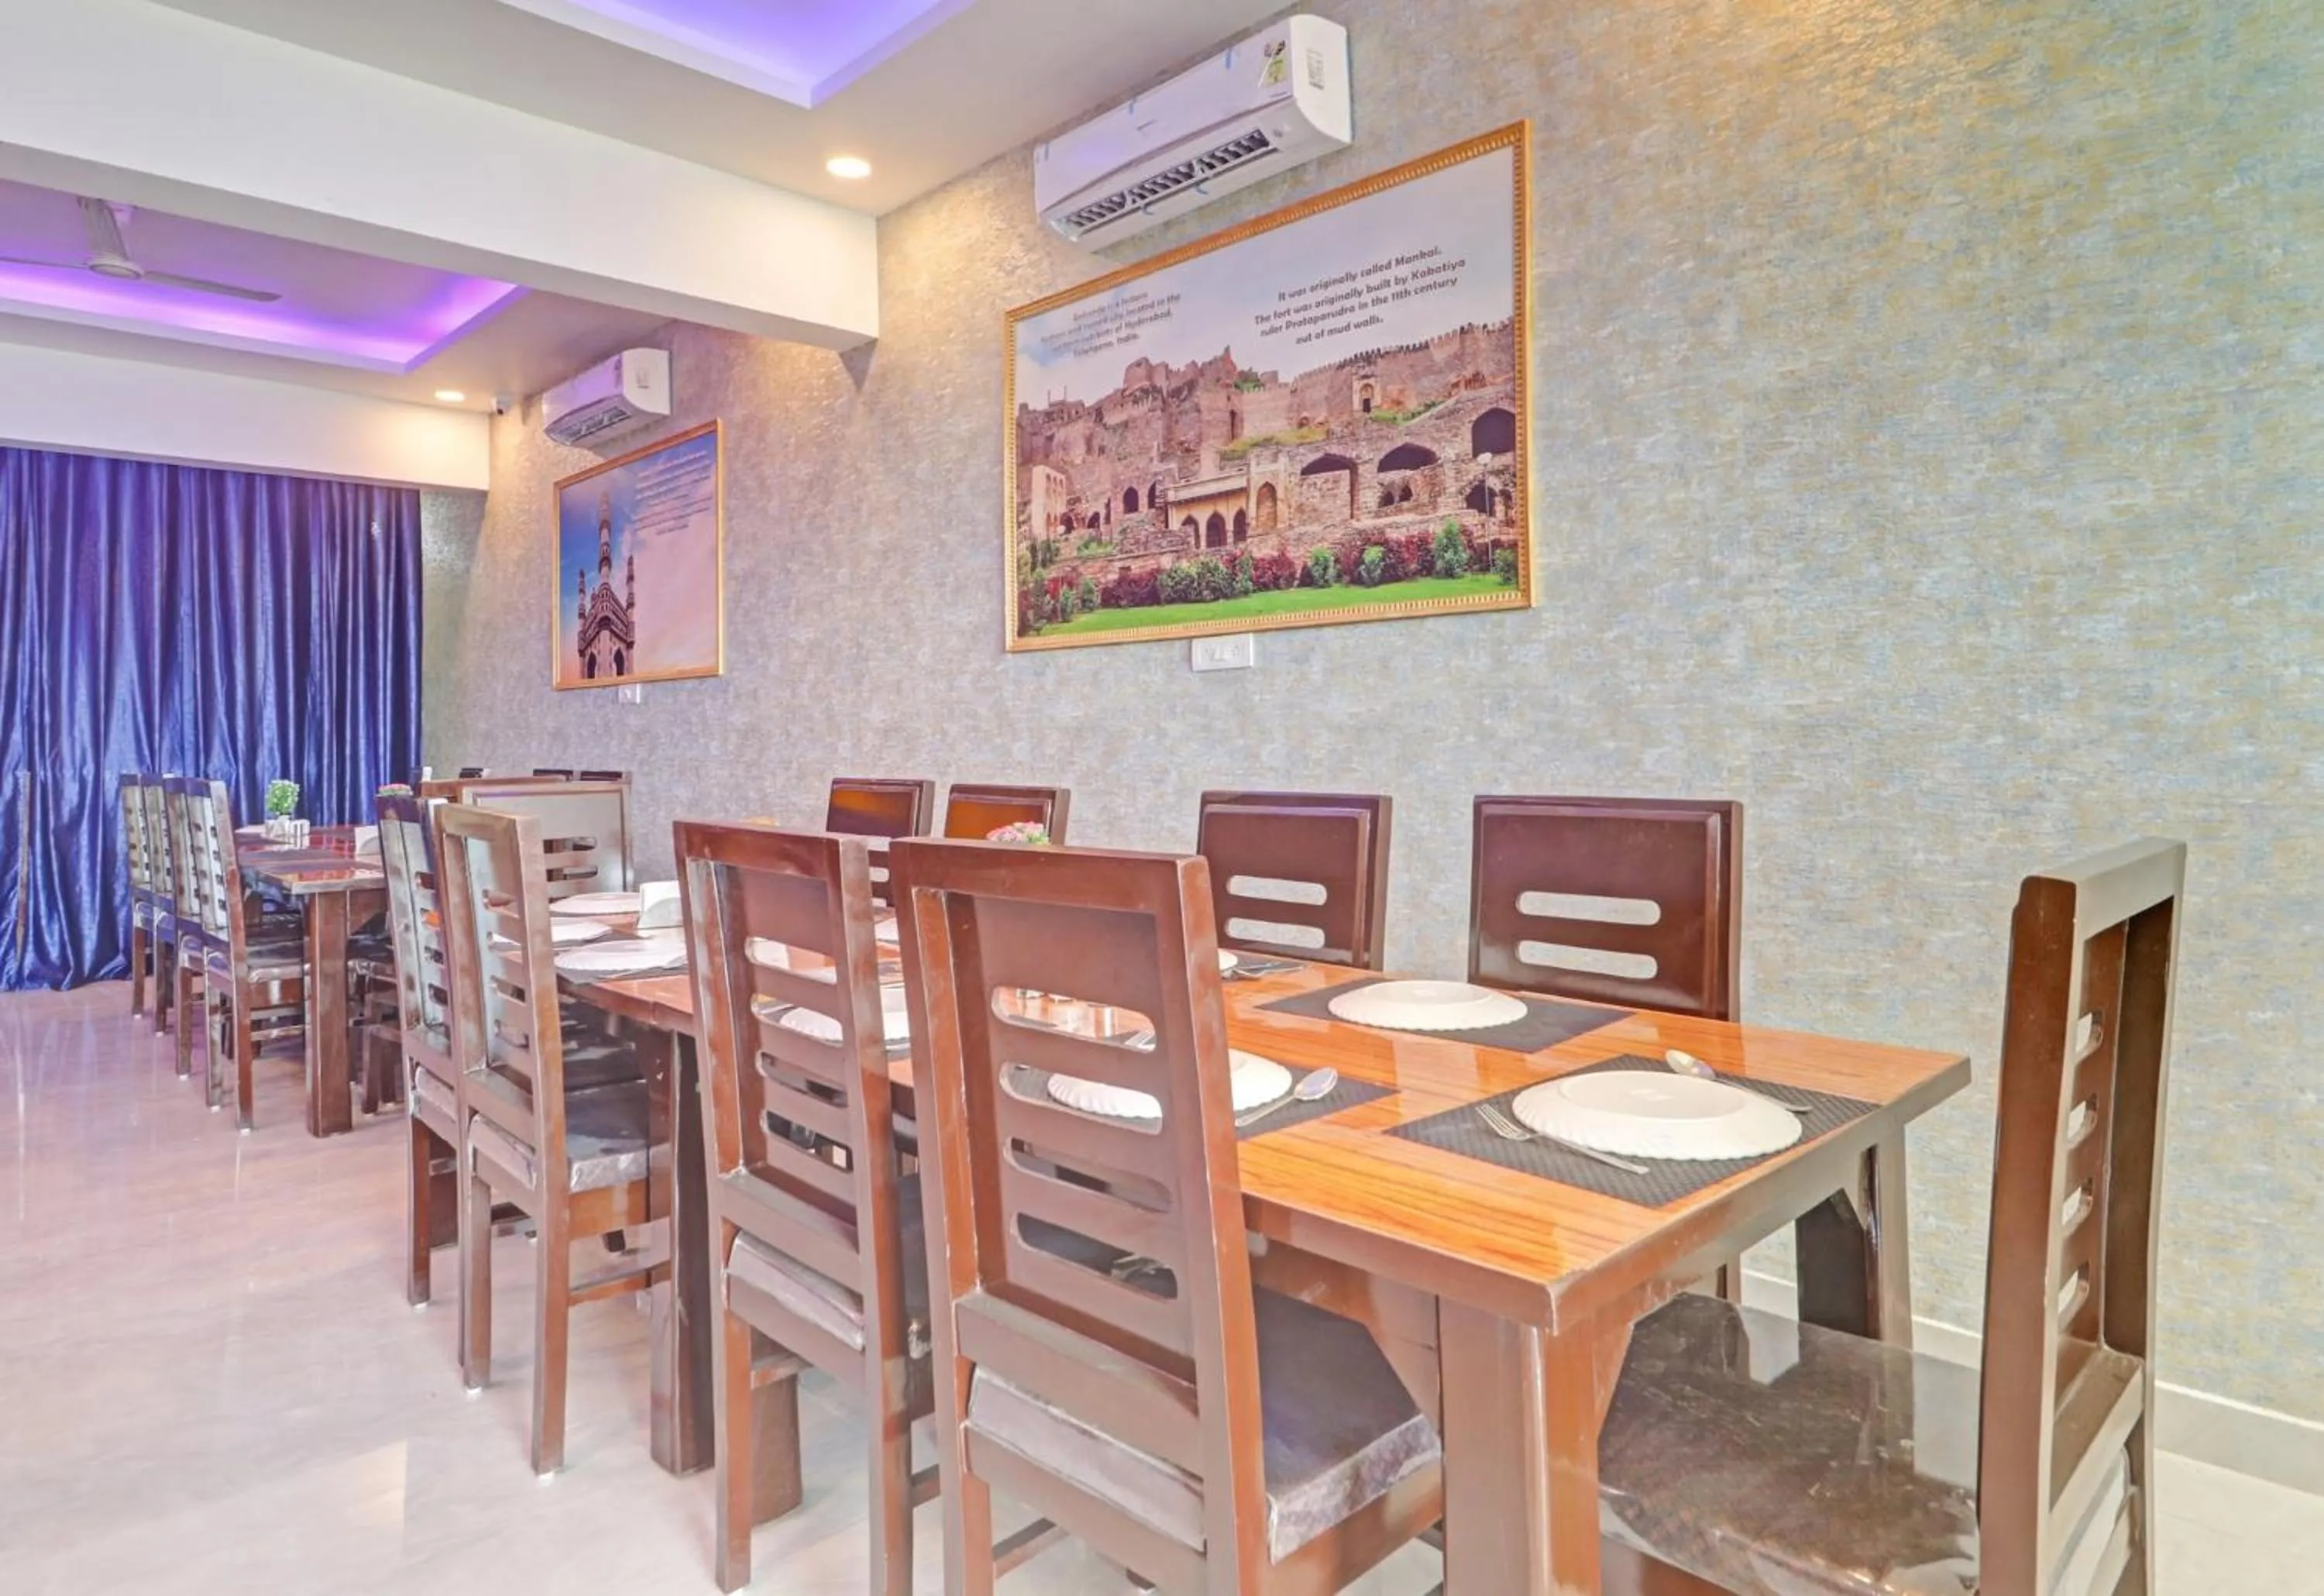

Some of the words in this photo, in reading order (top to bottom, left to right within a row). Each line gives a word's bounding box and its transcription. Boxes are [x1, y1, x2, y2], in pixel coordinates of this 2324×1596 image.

[1287, 287, 1306, 298] was
[1309, 272, 1358, 293] originally
[1360, 259, 1392, 278] called
[1371, 295, 1389, 307] the
[1413, 277, 1458, 295] century
[1255, 315, 1271, 325] The
[1273, 308, 1291, 319] fort
[1293, 303, 1312, 314] was
[1315, 287, 1363, 308] originally
[1366, 277, 1391, 294] built
[1394, 276, 1408, 286] by
[1315, 328, 1325, 339] of
[1327, 322, 1351, 336] mud
